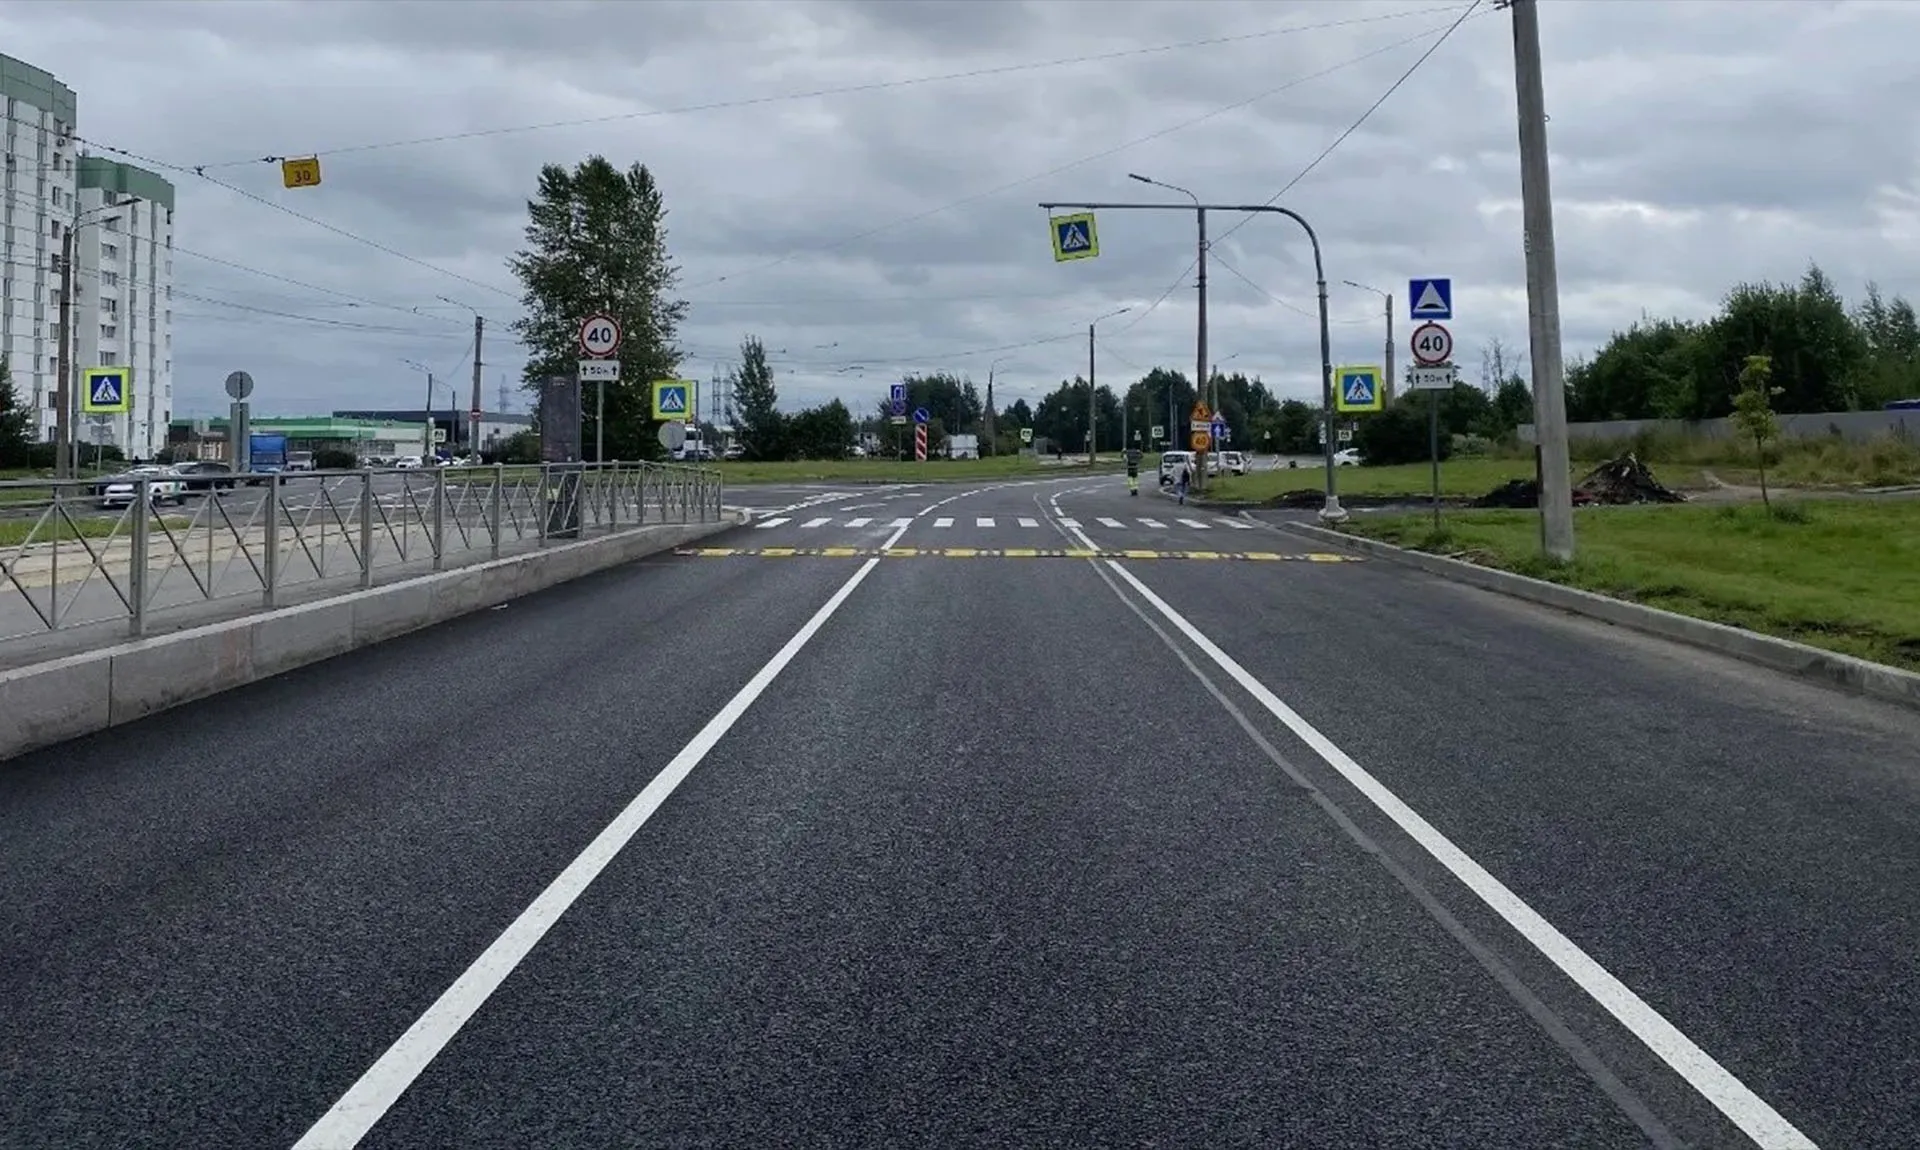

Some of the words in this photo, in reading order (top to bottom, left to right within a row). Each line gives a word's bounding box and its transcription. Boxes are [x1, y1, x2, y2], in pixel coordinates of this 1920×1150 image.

[295, 170, 311, 183] 30
[587, 327, 612, 343] 40
[1419, 335, 1444, 352] 40
